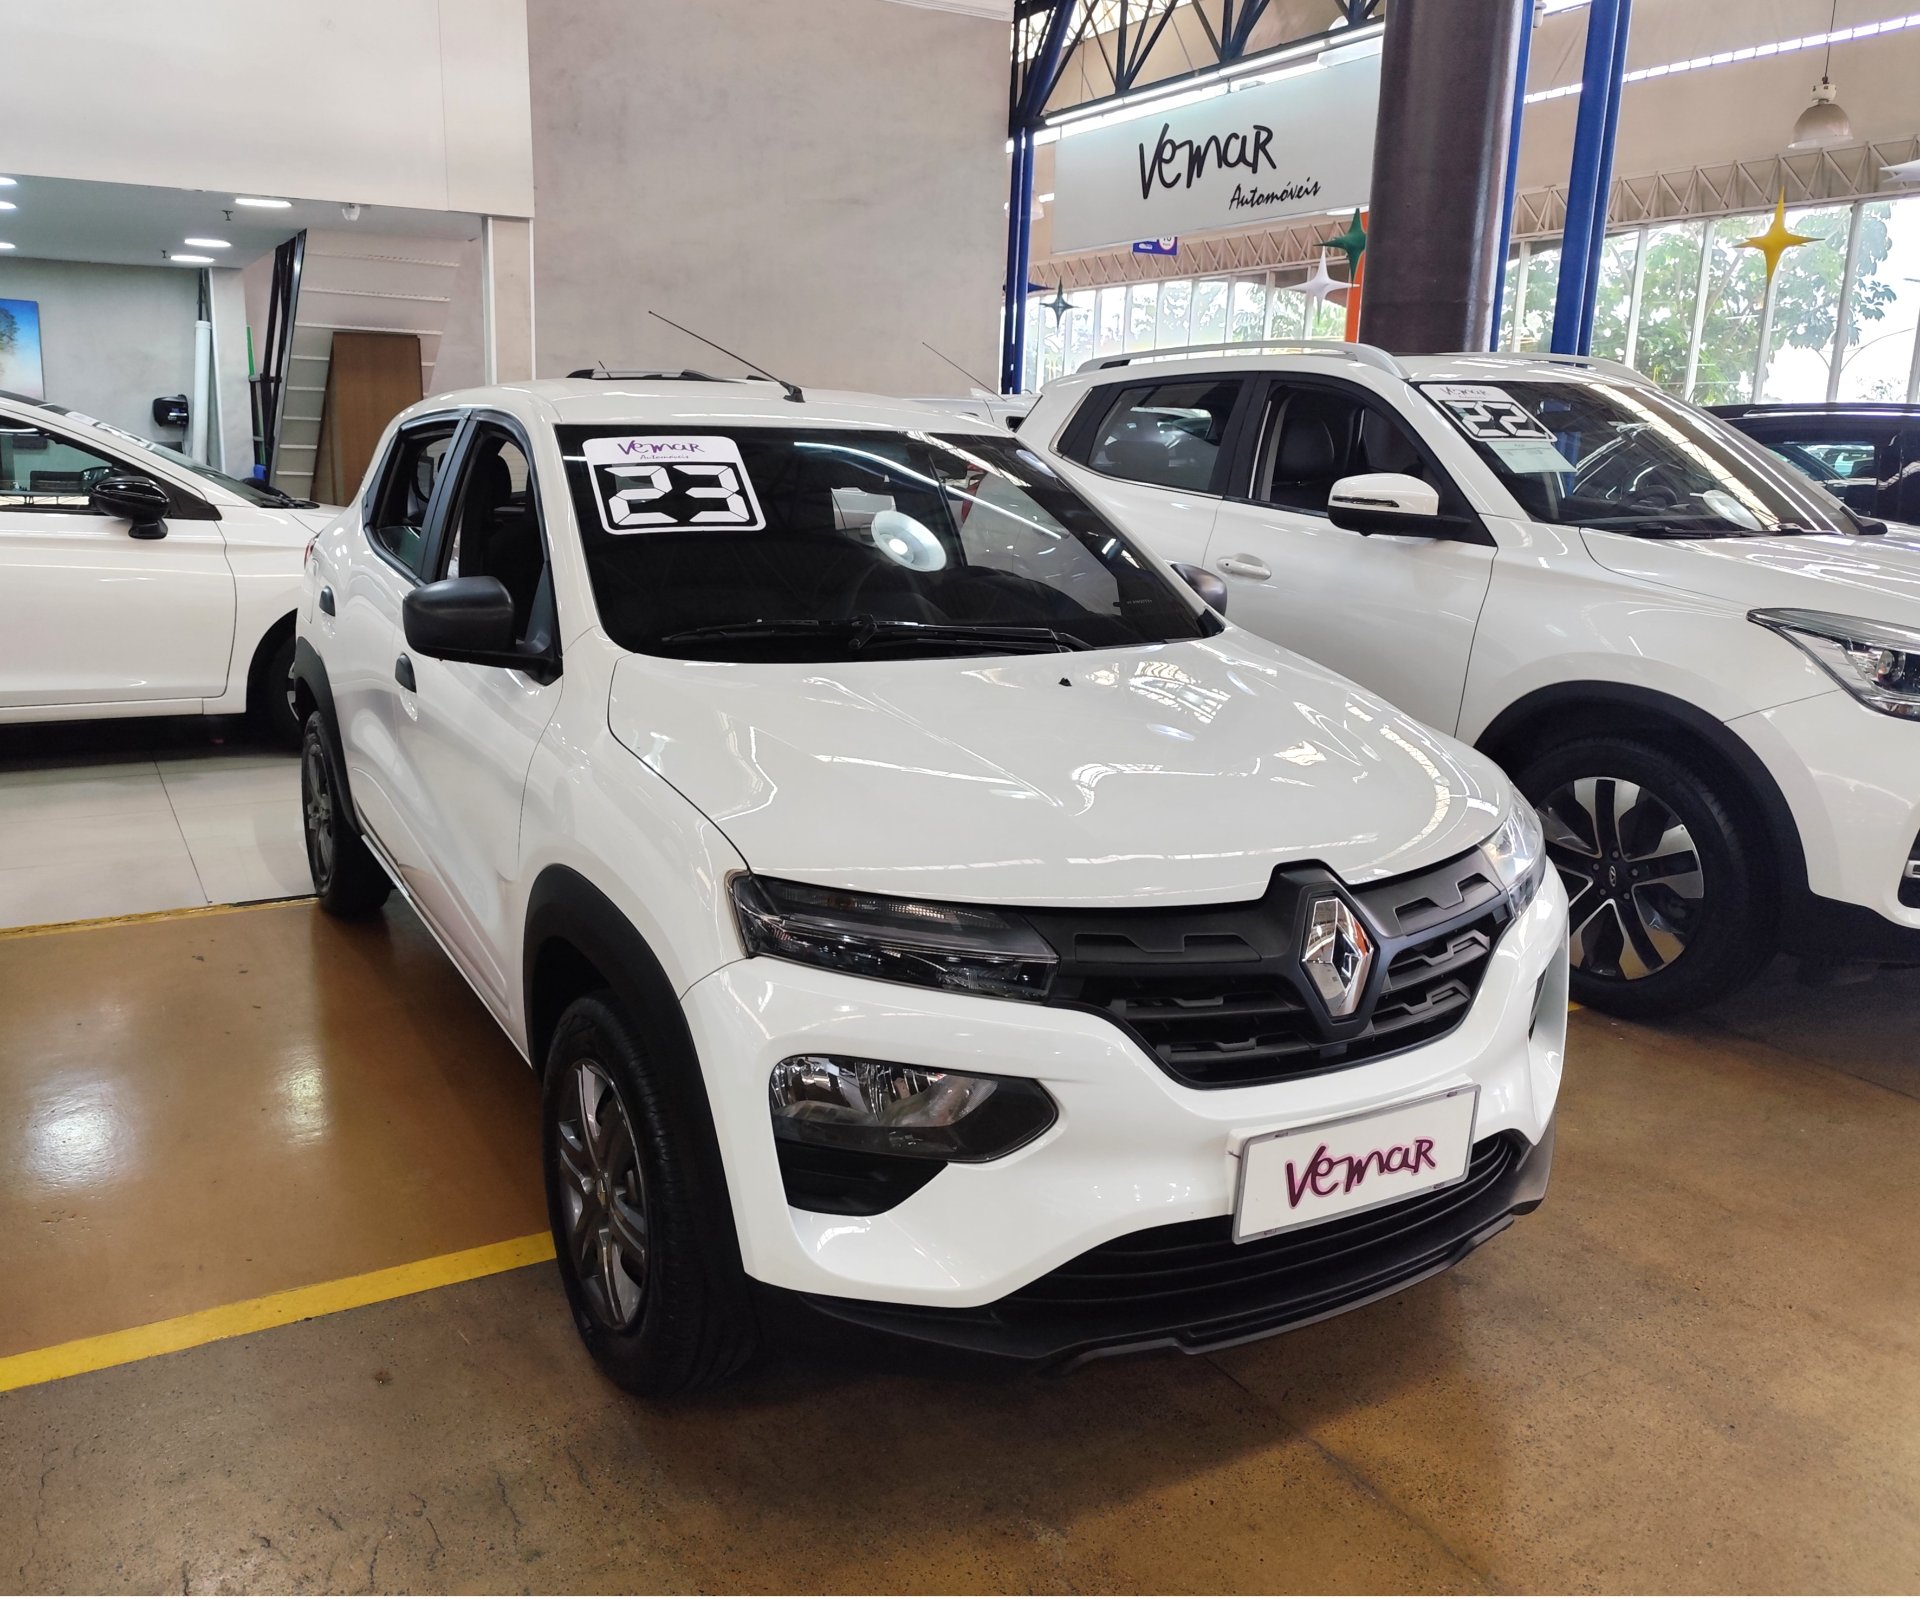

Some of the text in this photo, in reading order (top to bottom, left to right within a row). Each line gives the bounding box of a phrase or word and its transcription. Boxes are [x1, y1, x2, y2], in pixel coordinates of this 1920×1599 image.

[1228, 176, 1321, 210] Automóveis
[1445, 401, 1547, 437] 22
[604, 465, 750, 525] 23
